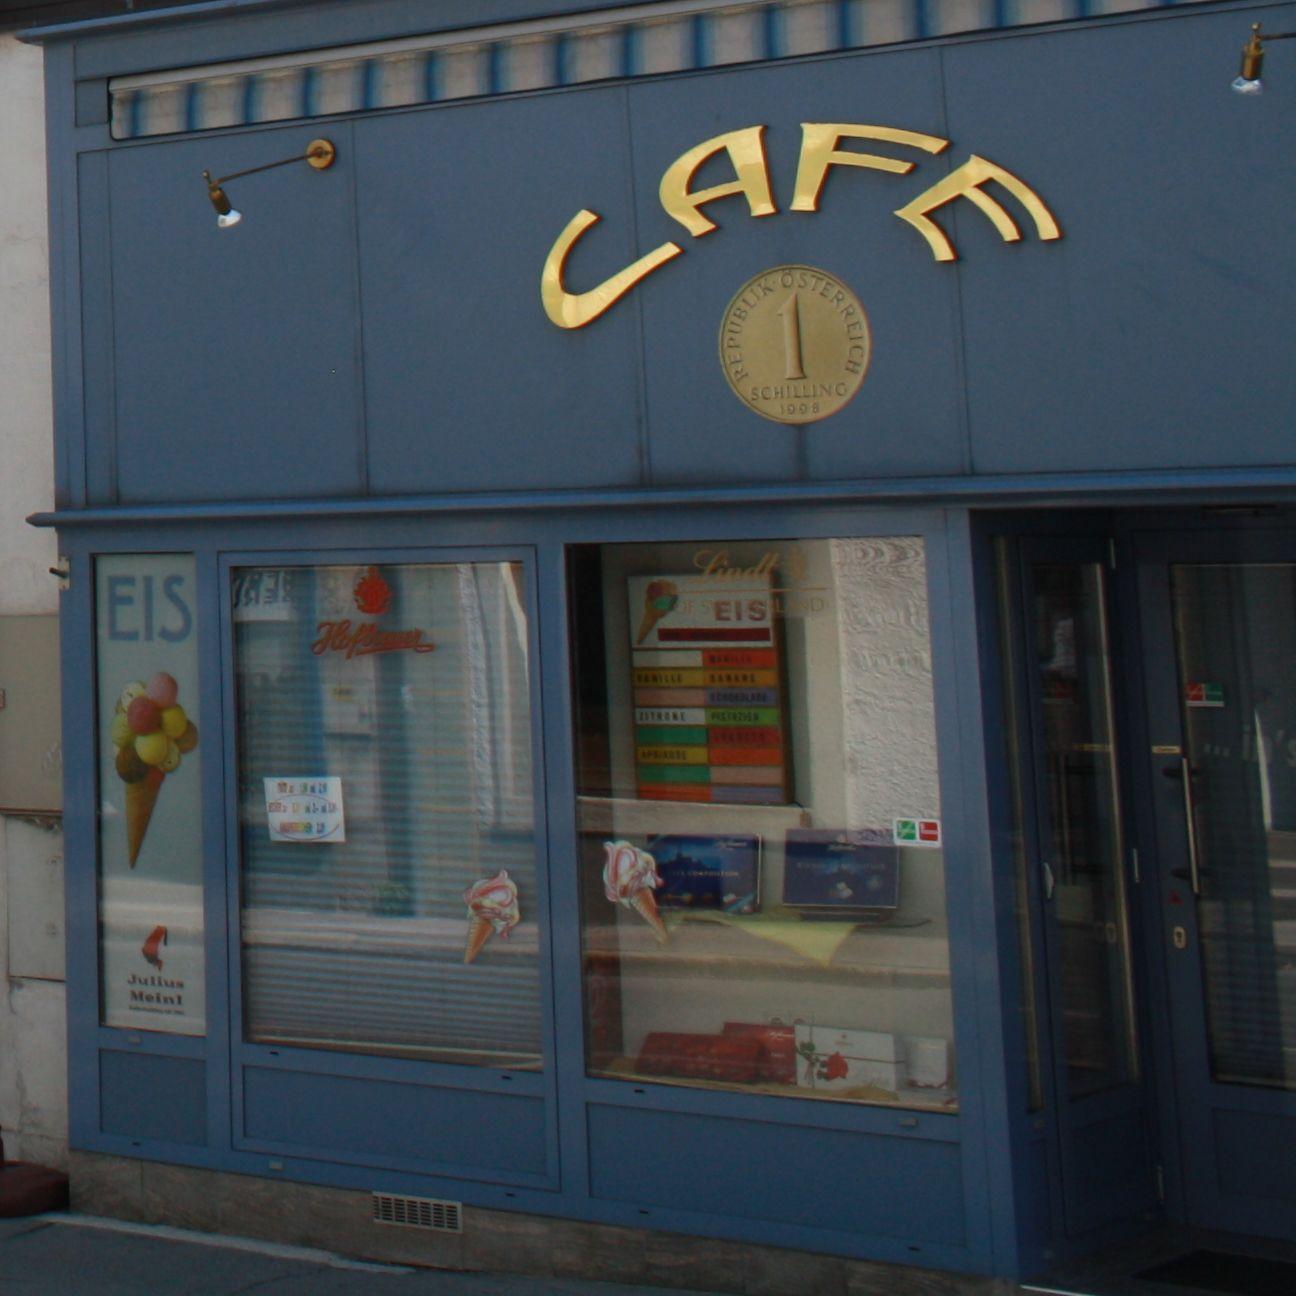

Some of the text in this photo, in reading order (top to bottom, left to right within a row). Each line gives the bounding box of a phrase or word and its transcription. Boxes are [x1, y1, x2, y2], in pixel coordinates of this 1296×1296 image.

[540, 122, 1063, 330] CAFE
[780, 268, 865, 375] ÖSTERREICH
[777, 288, 807, 380] 1
[750, 381, 848, 402] SCHILLING
[108, 573, 193, 643] EIS
[714, 599, 768, 622] EIS
[639, 710, 687, 722] ZITRONE
[127, 973, 185, 989] Julius
[129, 989, 183, 1006] Meinl
